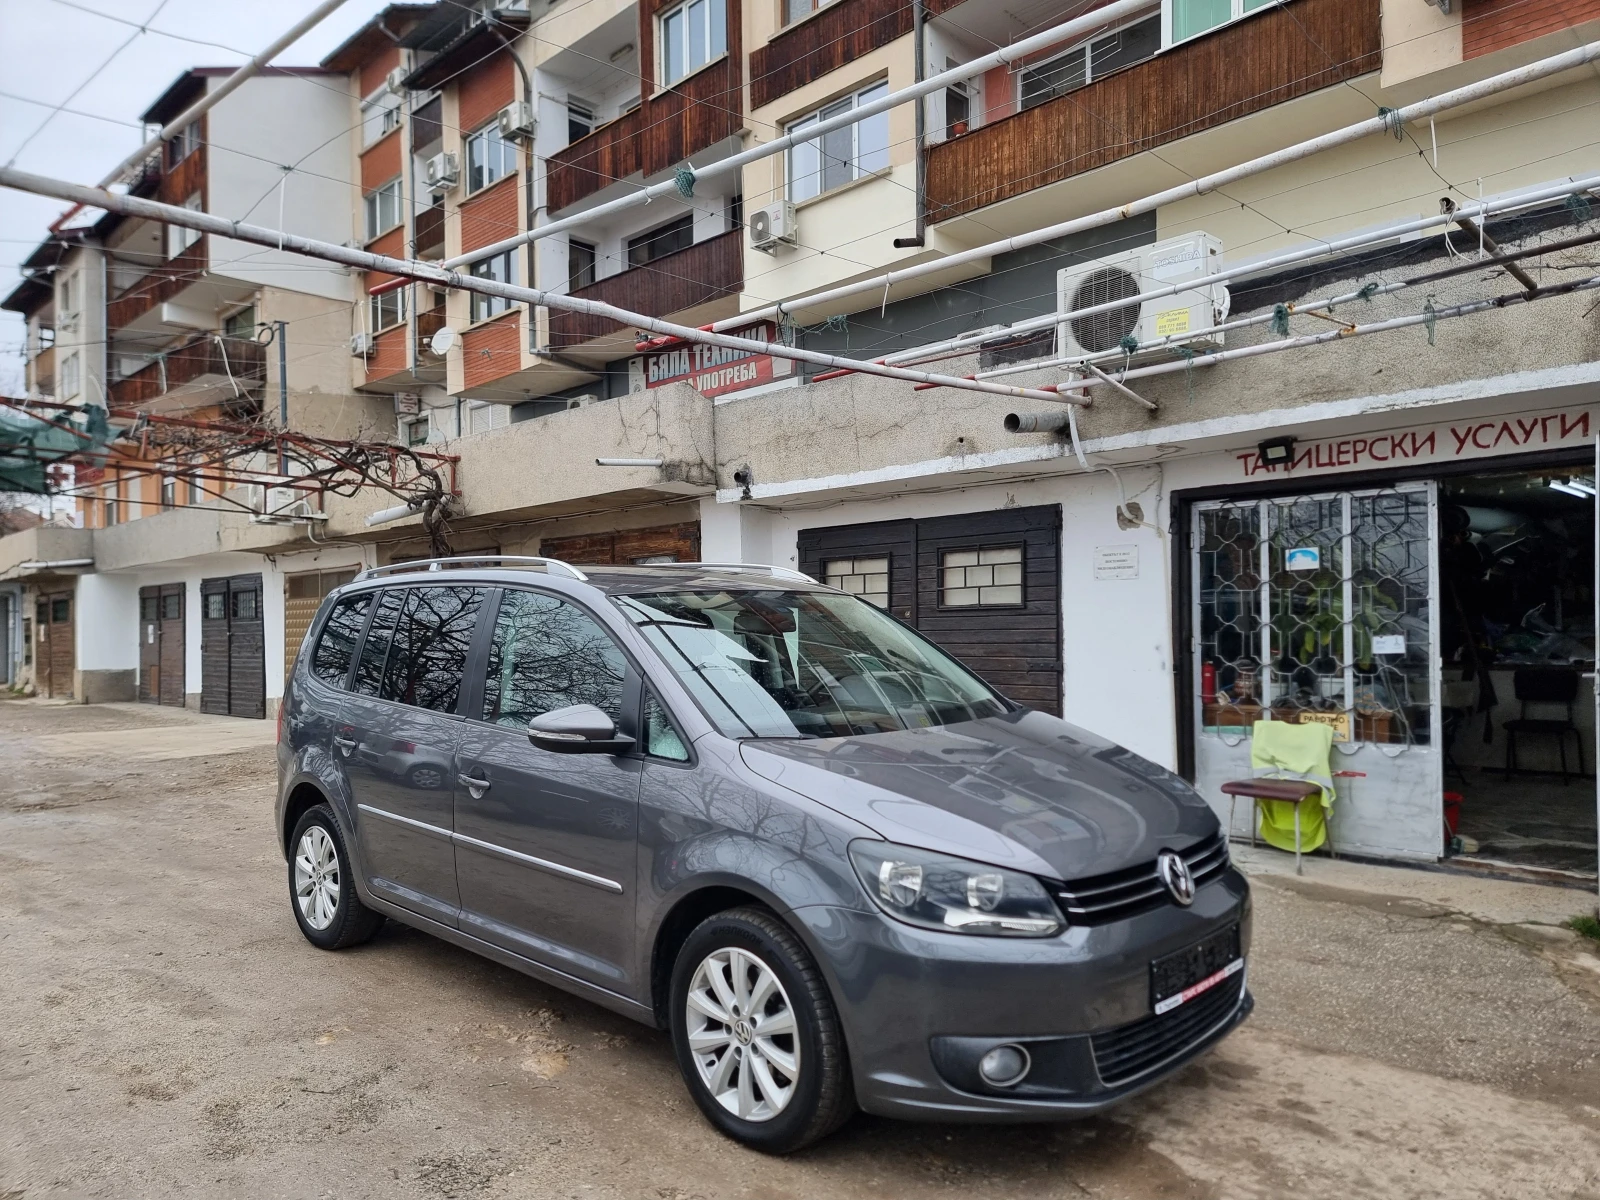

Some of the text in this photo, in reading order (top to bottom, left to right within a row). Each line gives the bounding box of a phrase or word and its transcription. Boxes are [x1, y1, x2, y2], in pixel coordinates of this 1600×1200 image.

[1154, 250, 1200, 268] TOSHIBA
[649, 347, 690, 383] БЯЛА
[696, 362, 757, 392] УПОТРЕБА
[1236, 411, 1590, 476] ТАИЦЕРСКИ УСЛУГИ
